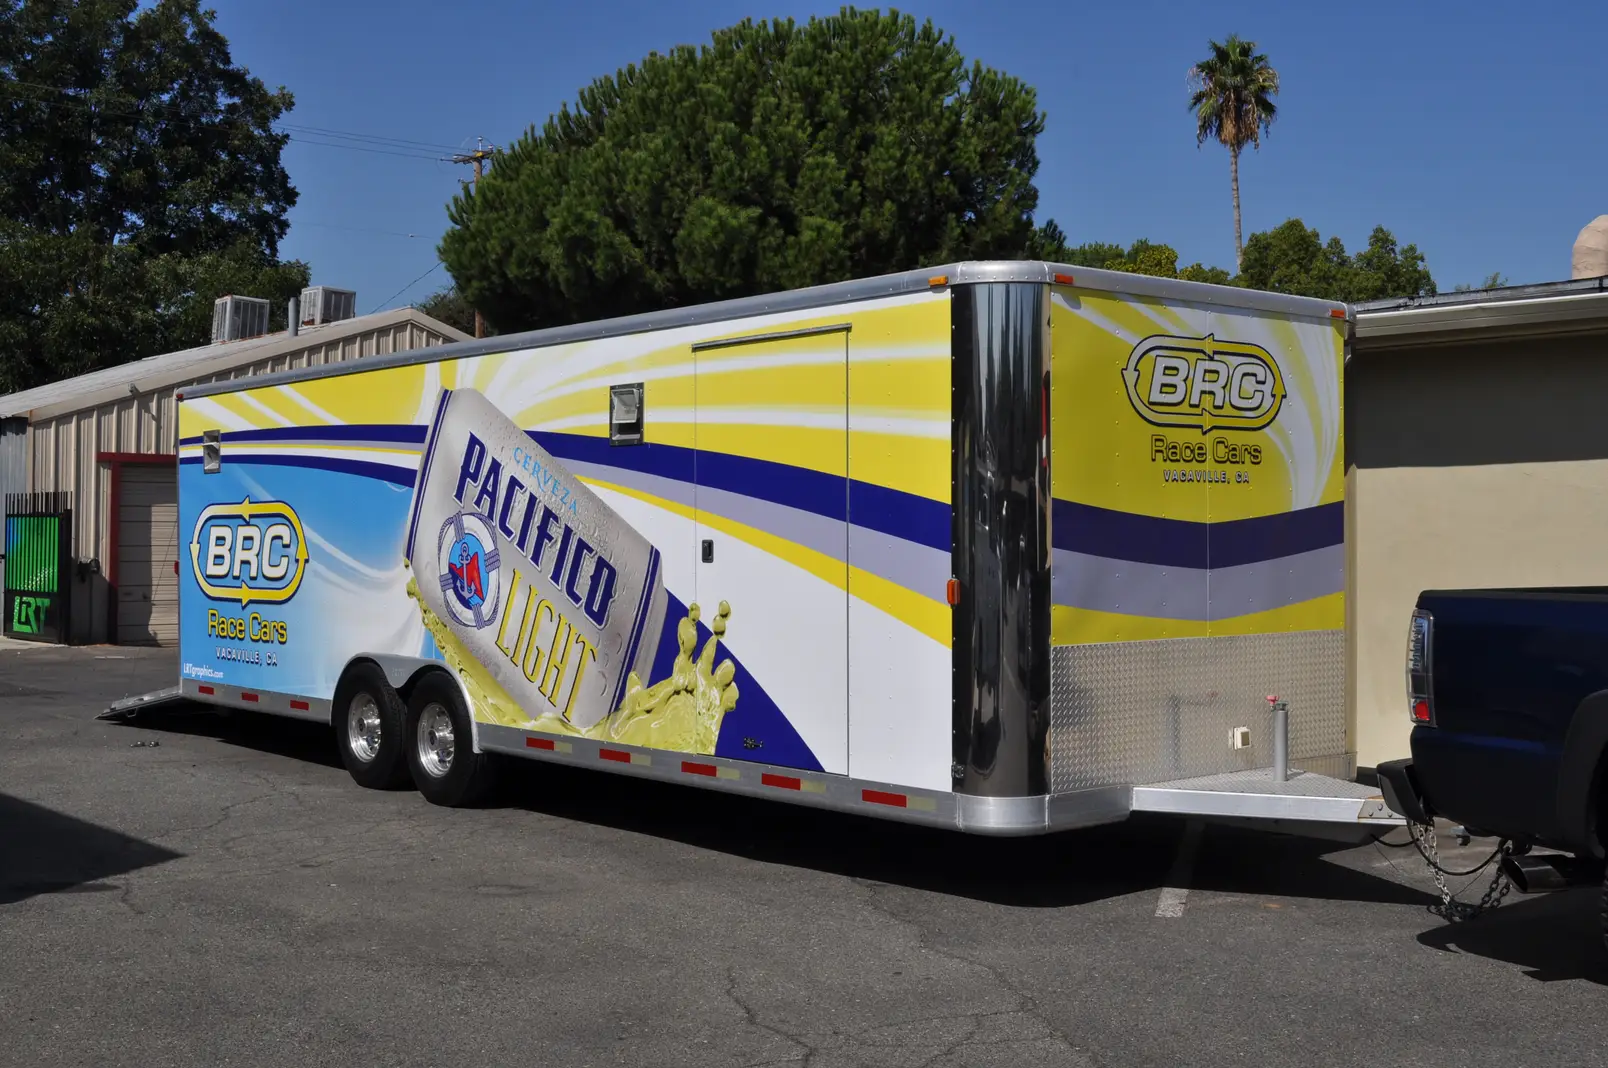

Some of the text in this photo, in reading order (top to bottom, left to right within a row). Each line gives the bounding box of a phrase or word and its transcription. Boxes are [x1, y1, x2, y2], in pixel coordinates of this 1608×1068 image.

[1147, 354, 1267, 411] BRC
[1150, 434, 1262, 465] Race Cars
[513, 446, 577, 515] CERVEZA
[1163, 469, 1249, 484] VACAVILLE, CA
[206, 523, 292, 582] BRC
[453, 431, 618, 630] PACIFICO
[13, 596, 51, 634] LRT
[208, 608, 287, 644] Race Cars
[215, 646, 278, 667] VACAVILLE, CA
[495, 568, 598, 724] LIGHT
